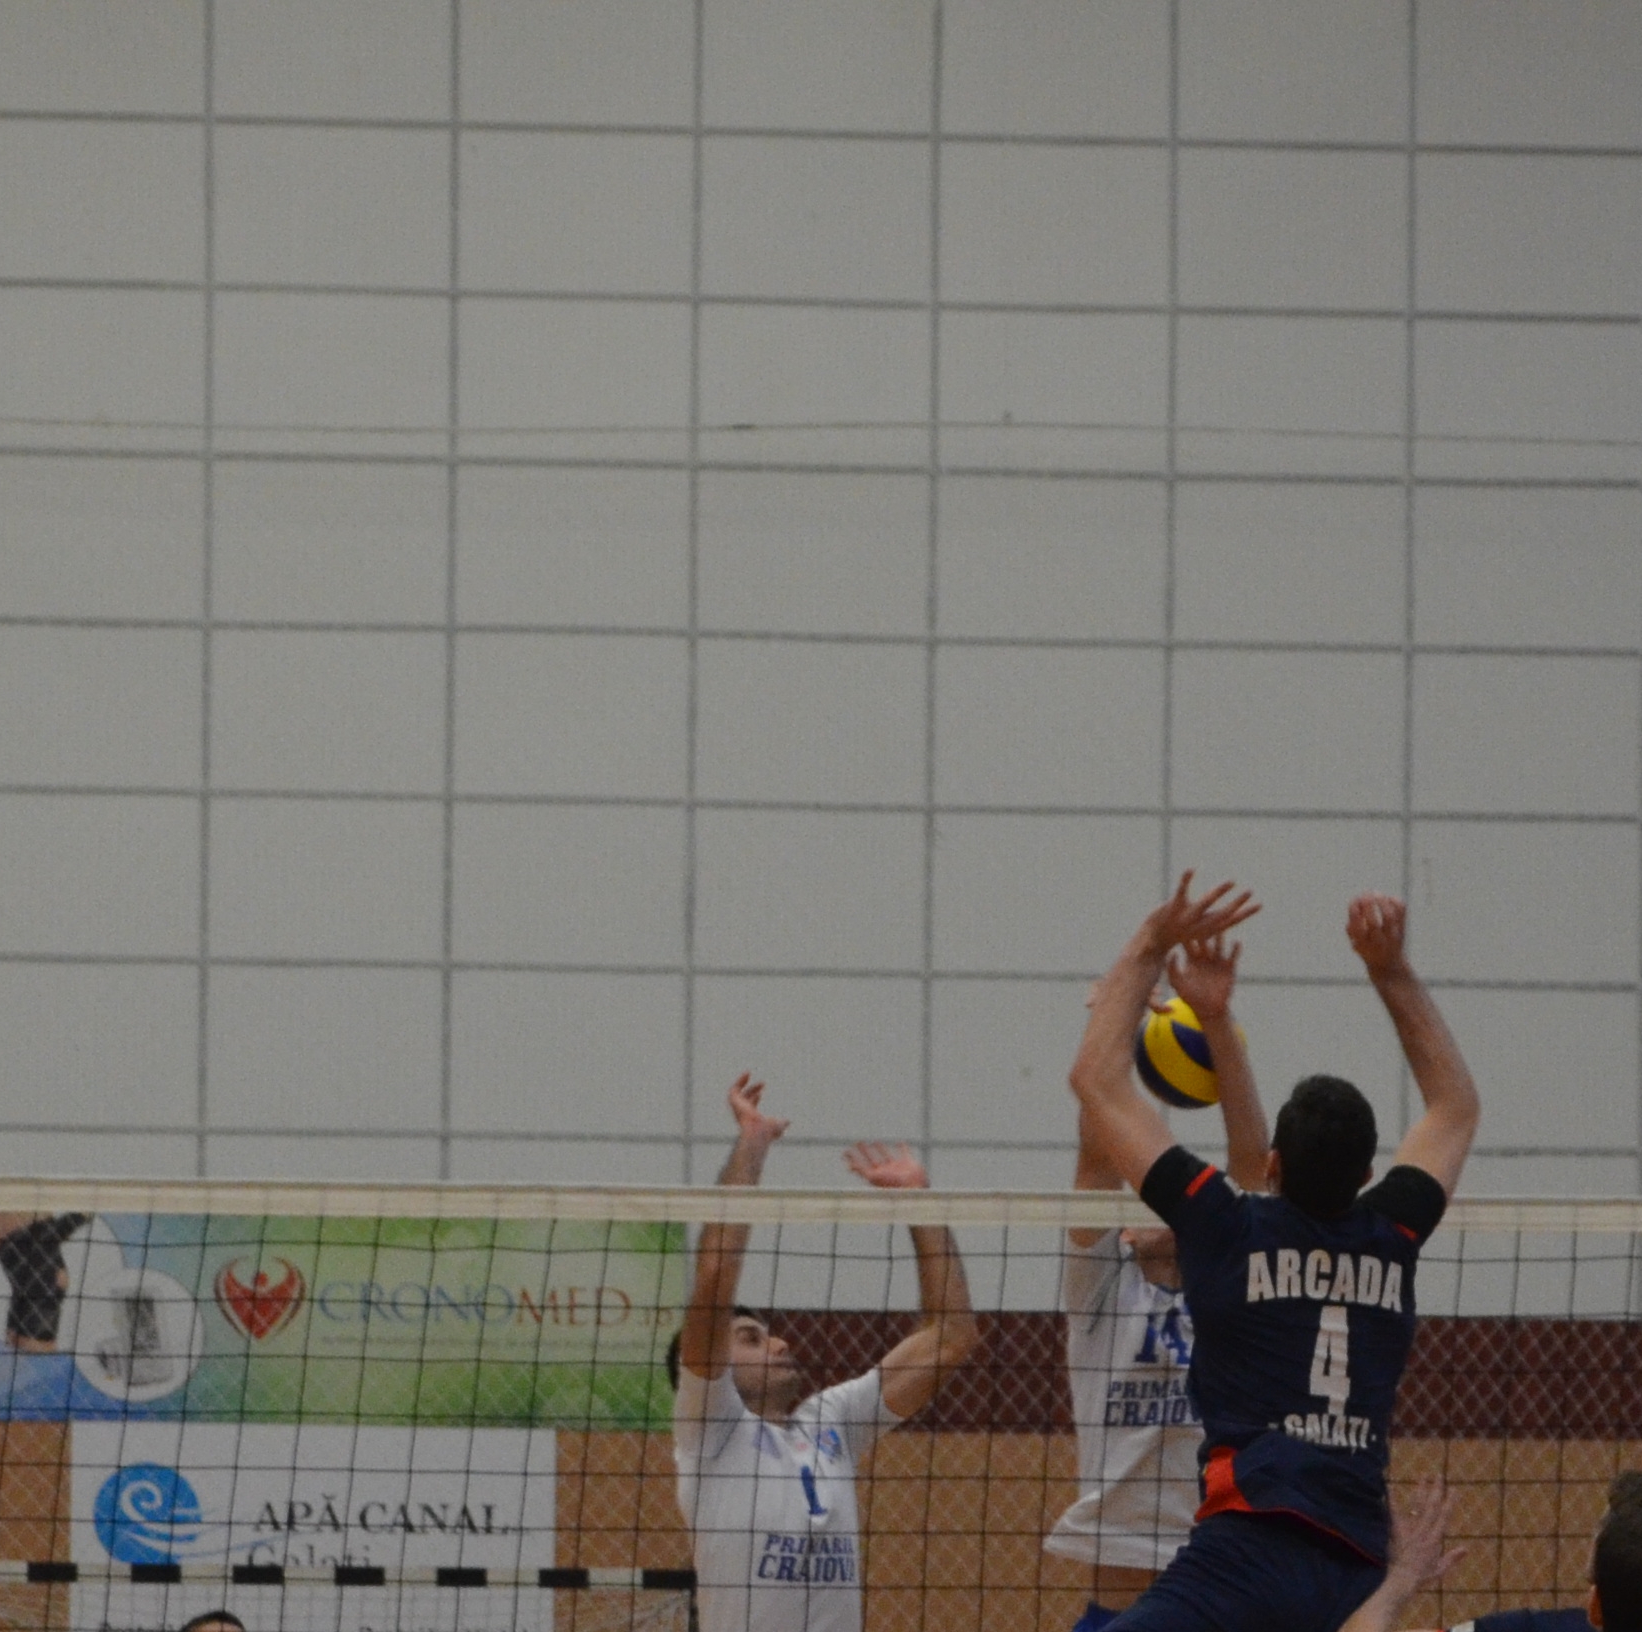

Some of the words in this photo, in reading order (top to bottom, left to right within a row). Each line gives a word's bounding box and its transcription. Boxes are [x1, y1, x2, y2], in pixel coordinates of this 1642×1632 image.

[1246, 1248, 1403, 1313] ARCADA
[1309, 1305, 1351, 1417] 4
[254, 1492, 345, 1533] APĂ
[358, 1501, 498, 1536] CANAL
[799, 1465, 829, 1515] 1
